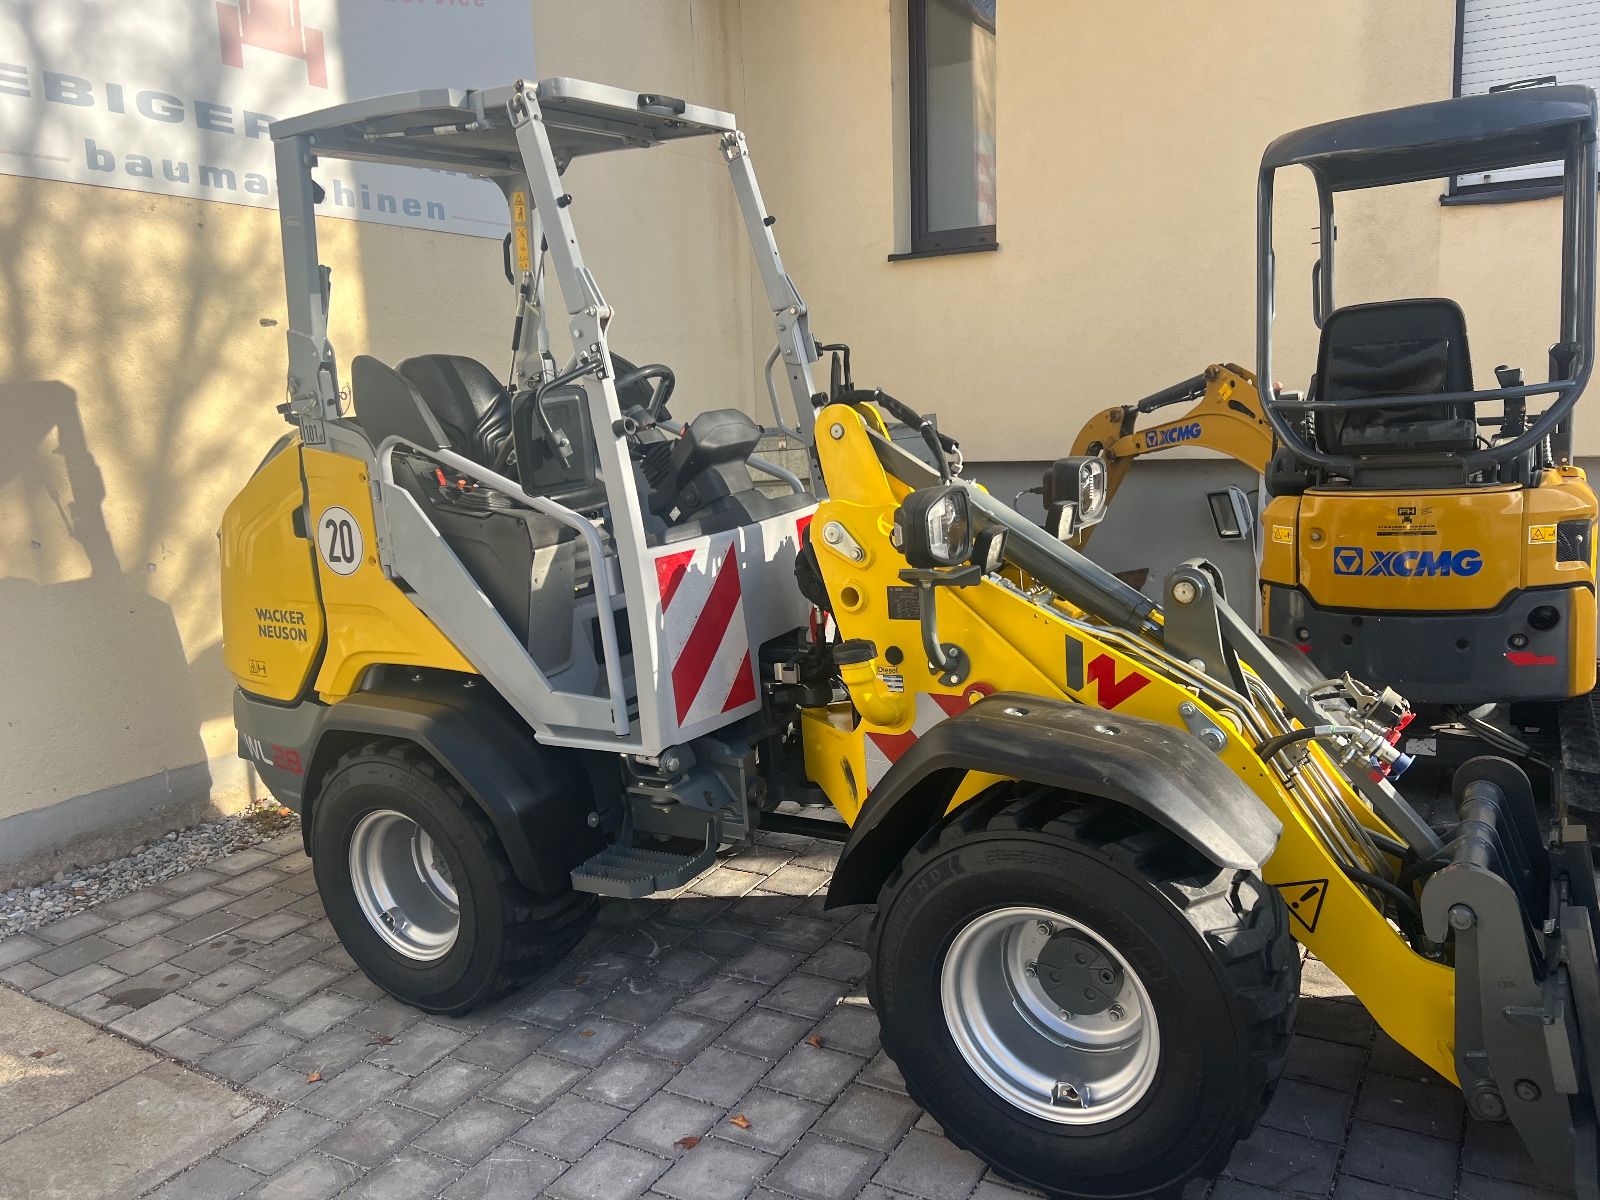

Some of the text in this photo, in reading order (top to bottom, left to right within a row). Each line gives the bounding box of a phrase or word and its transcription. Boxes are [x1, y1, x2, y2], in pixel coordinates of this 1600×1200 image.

[84, 138, 446, 221] baumahinen
[1160, 422, 1202, 446] XCMG
[325, 518, 355, 564] 20
[1364, 549, 1483, 577] XCMG
[255, 607, 306, 626] WACKER
[258, 624, 308, 642] NEUSON
